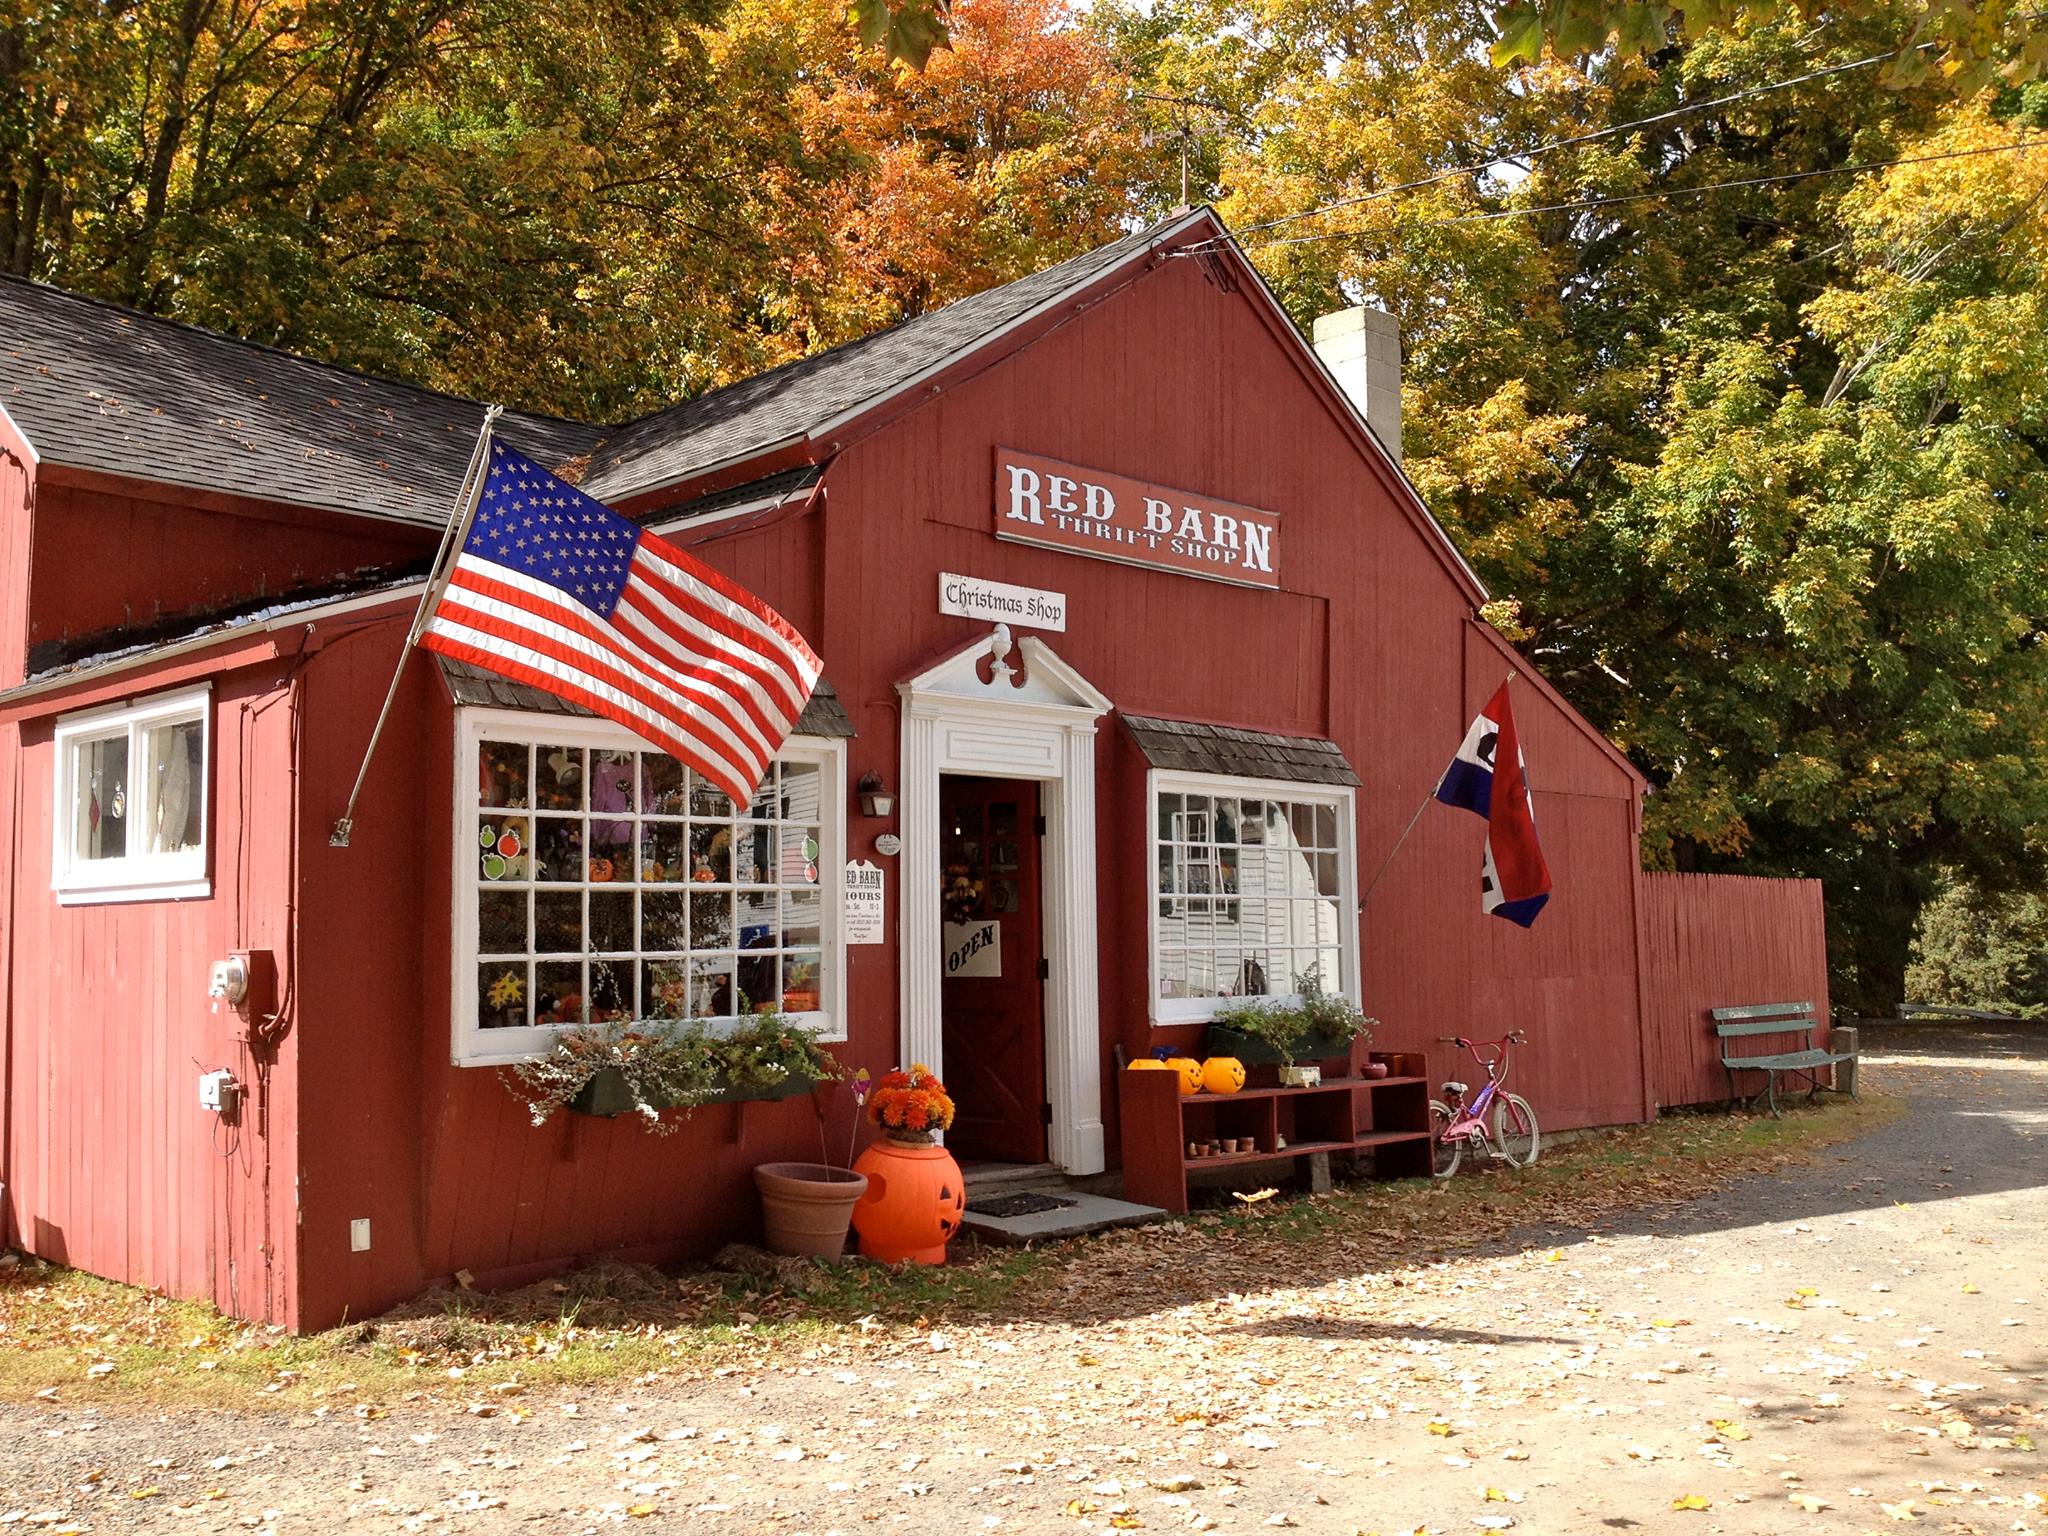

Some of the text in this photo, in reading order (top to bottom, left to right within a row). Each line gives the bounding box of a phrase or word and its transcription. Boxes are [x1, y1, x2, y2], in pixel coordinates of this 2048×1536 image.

[1005, 464, 1273, 573] RED BARN
[1051, 513, 1238, 564] THRIFT SHOP
[946, 582, 1061, 624] Christmas Shop
[846, 870, 881, 888] ED BARN
[949, 924, 994, 971] OPEN
